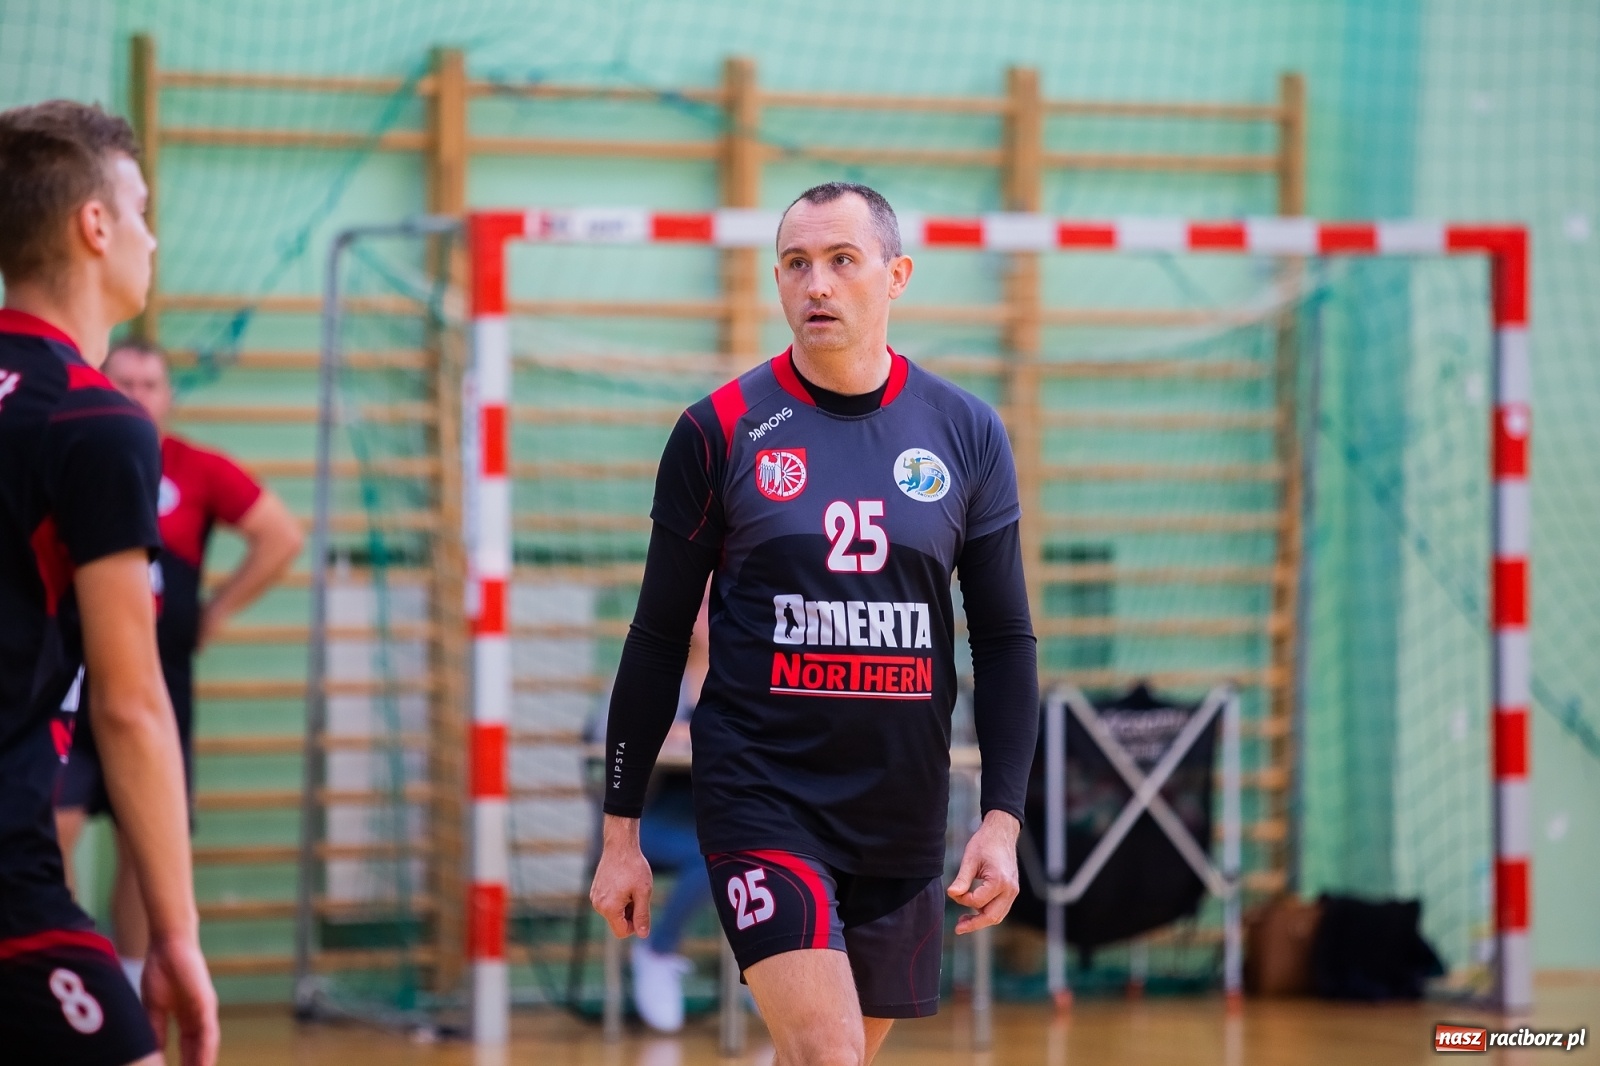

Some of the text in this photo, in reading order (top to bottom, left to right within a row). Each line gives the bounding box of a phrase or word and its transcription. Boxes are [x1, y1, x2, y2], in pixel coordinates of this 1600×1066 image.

[824, 500, 890, 573] 25
[773, 594, 932, 648] OMERTA
[613, 741, 626, 789] KIPSTA
[727, 867, 775, 930] 25
[49, 967, 104, 1035] 8
